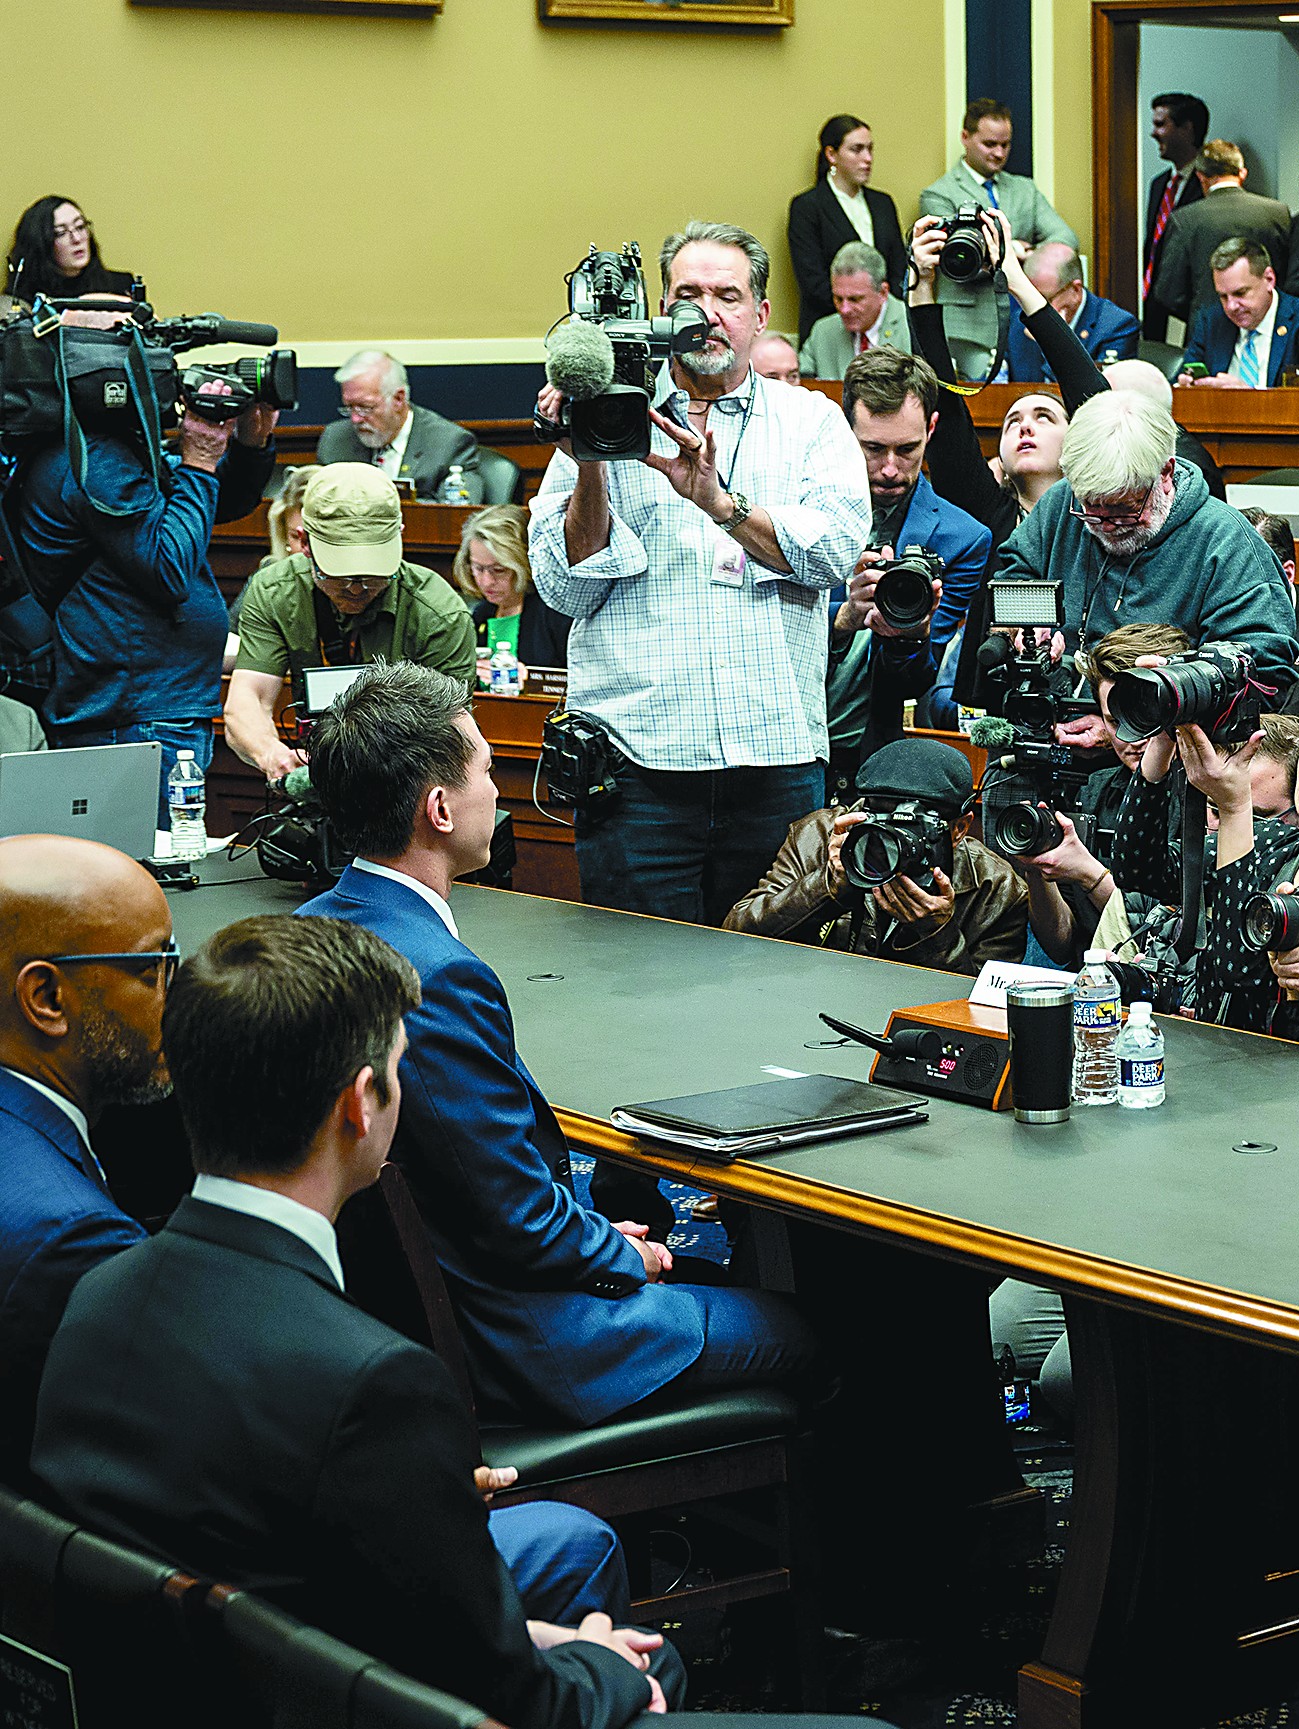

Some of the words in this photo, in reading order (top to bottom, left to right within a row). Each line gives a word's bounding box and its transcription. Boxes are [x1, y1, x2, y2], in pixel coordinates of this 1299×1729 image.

[893, 813, 913, 821] Nikon
[987, 975, 1006, 989] Mr.
[1073, 1006, 1097, 1017] DEER
[1073, 1016, 1099, 1025] PARK
[939, 1059, 956, 1071] 500
[1132, 1063, 1157, 1074] DEER
[1132, 1073, 1158, 1082] PARK
